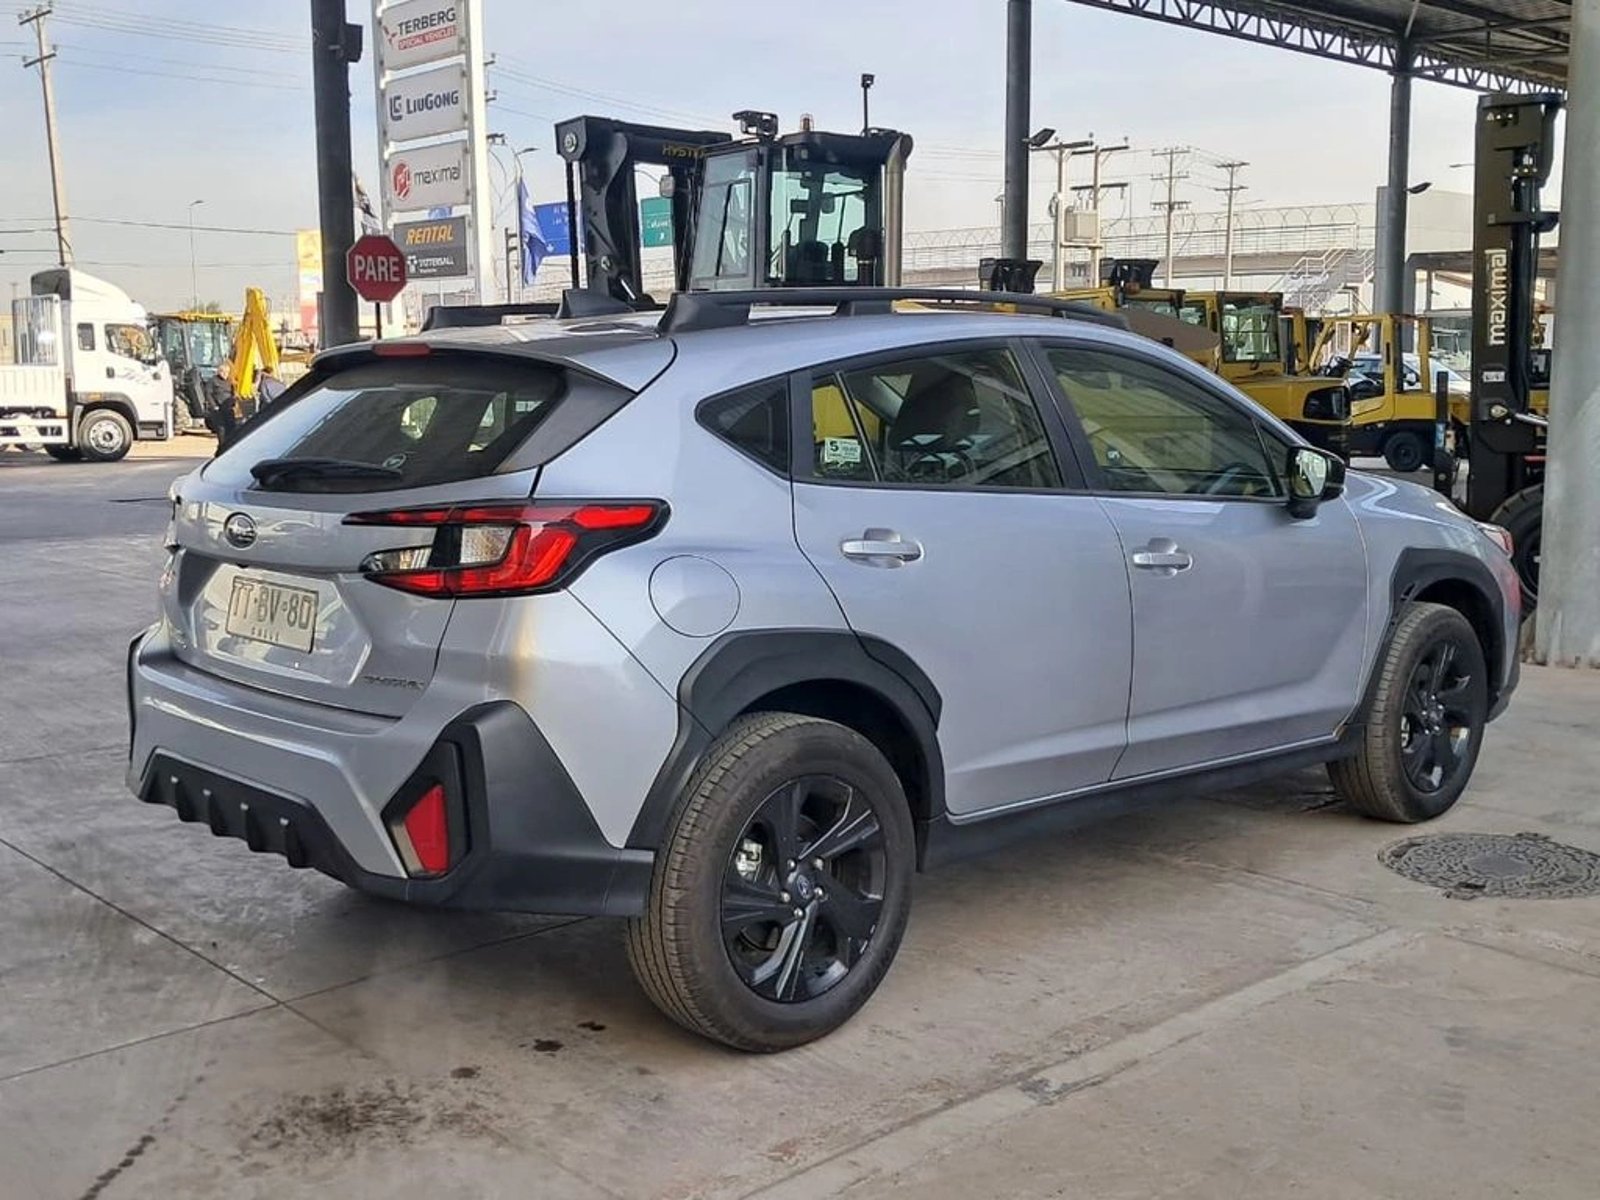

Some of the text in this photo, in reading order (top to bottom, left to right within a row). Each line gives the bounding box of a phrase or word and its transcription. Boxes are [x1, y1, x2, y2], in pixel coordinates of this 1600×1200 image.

[398, 7, 456, 36] TERBERG
[414, 159, 461, 185] maximal
[406, 224, 454, 245] RENTAL
[354, 255, 401, 282] PARE
[1485, 248, 1507, 345] maximal
